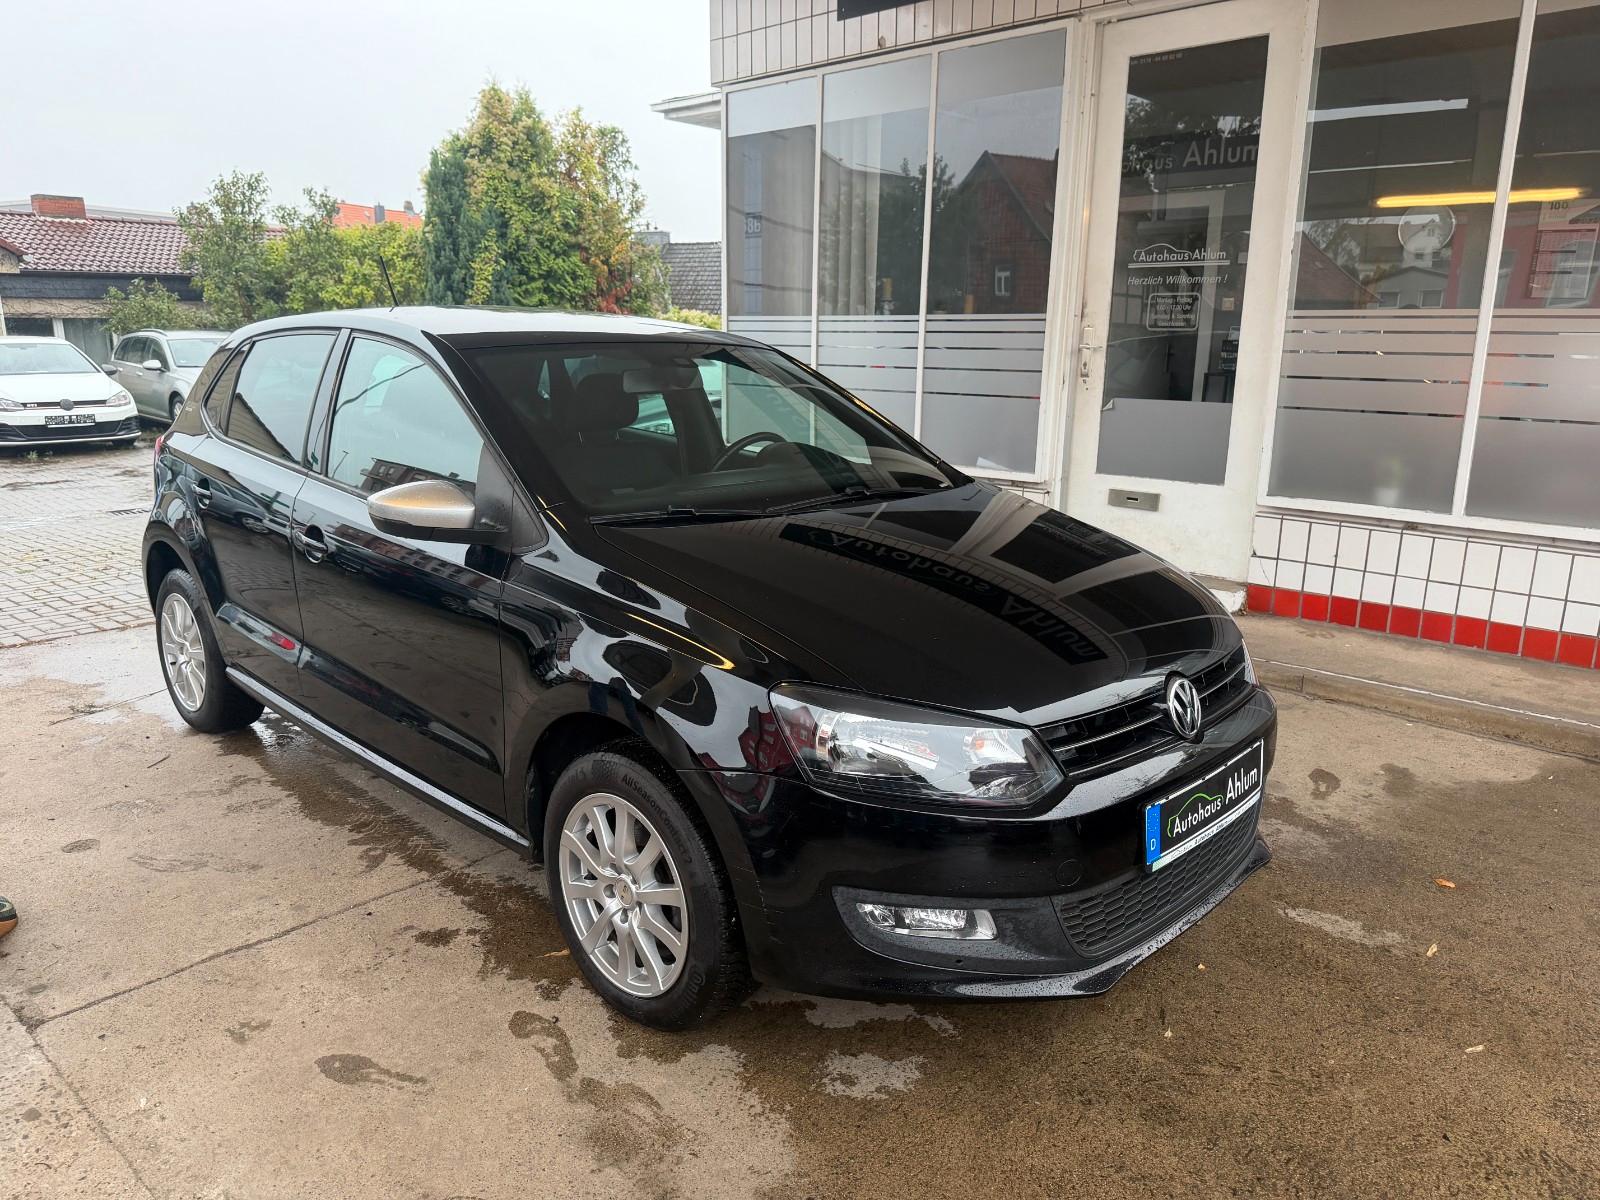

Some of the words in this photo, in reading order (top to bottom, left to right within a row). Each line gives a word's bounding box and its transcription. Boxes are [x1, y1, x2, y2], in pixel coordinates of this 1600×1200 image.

[1138, 249, 1189, 262] Autohaus
[1192, 248, 1227, 260] Ahlum
[1127, 275, 1163, 285] Herzlich
[1166, 275, 1222, 285] Willkommen
[1173, 798, 1222, 837] Autohaus
[1225, 766, 1258, 805] Ahlum
[1150, 838, 1156, 851] D
